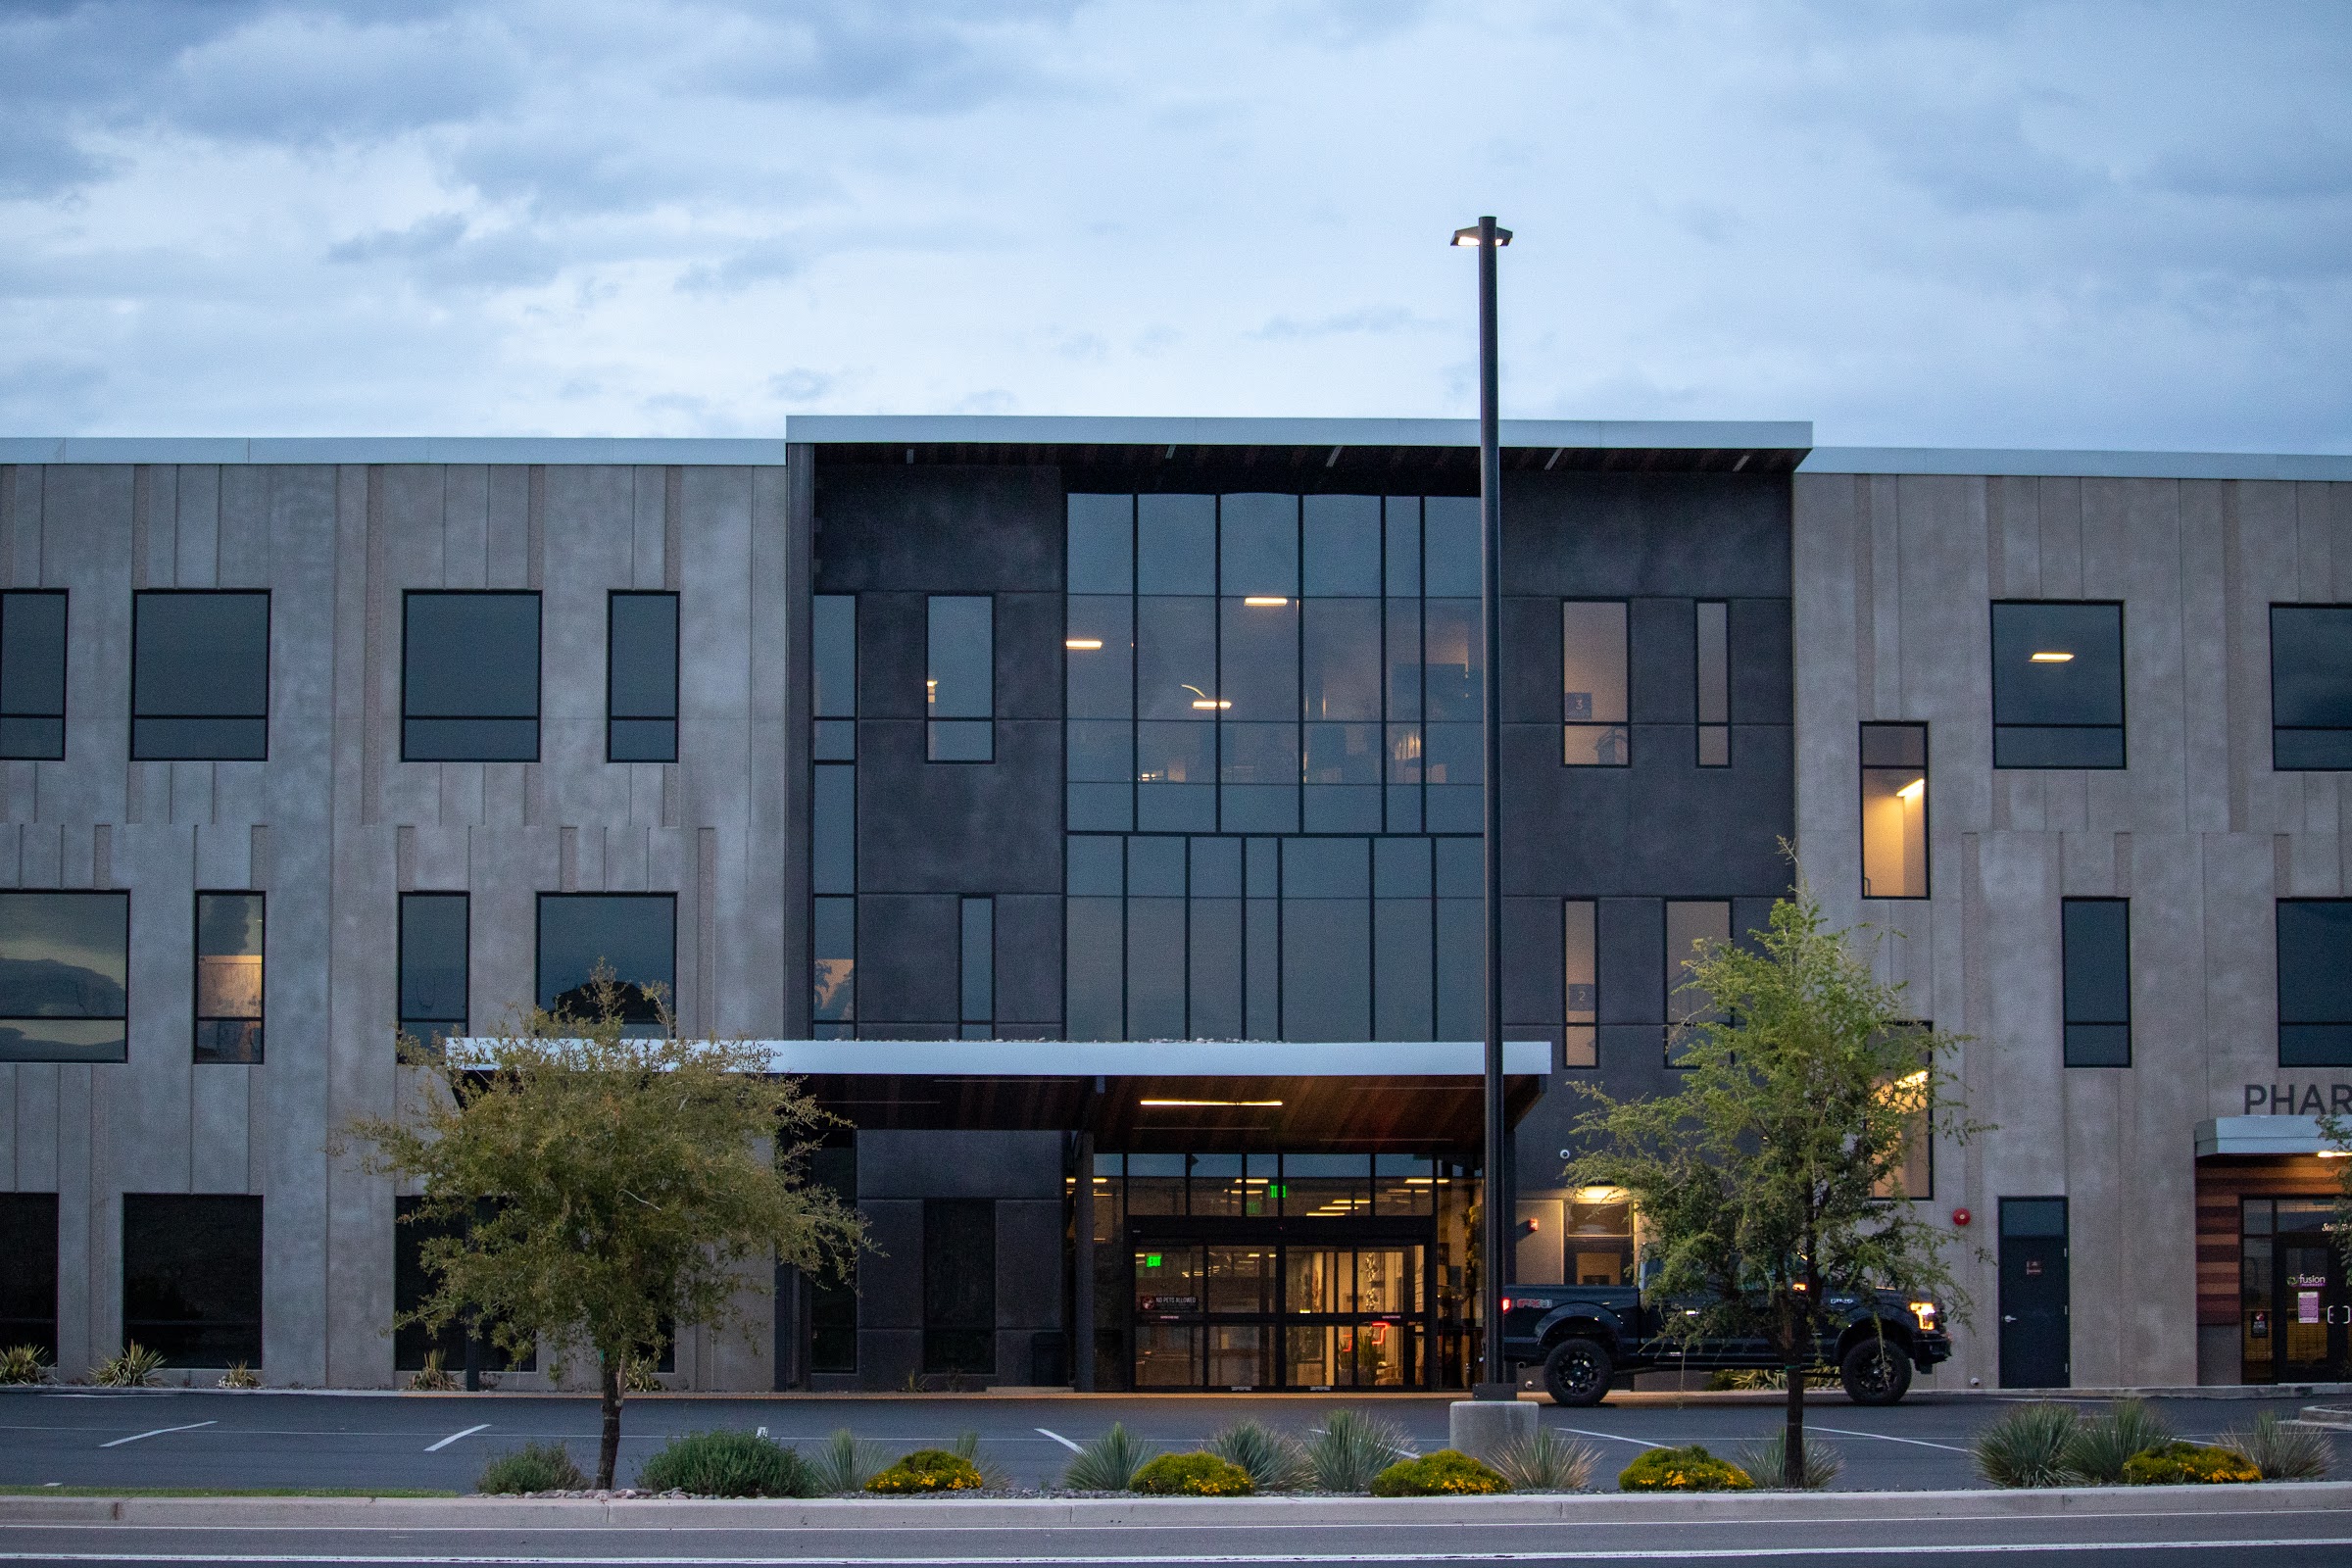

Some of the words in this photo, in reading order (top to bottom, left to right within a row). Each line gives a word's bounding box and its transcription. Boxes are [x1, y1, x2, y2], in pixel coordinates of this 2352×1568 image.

[1576, 699, 1583, 710] 3
[1579, 991, 1586, 1001] 2
[2244, 1084, 2352, 1115] PHAR
[1147, 1255, 1161, 1267] EXIT
[2299, 1274, 2326, 1284] fusion
